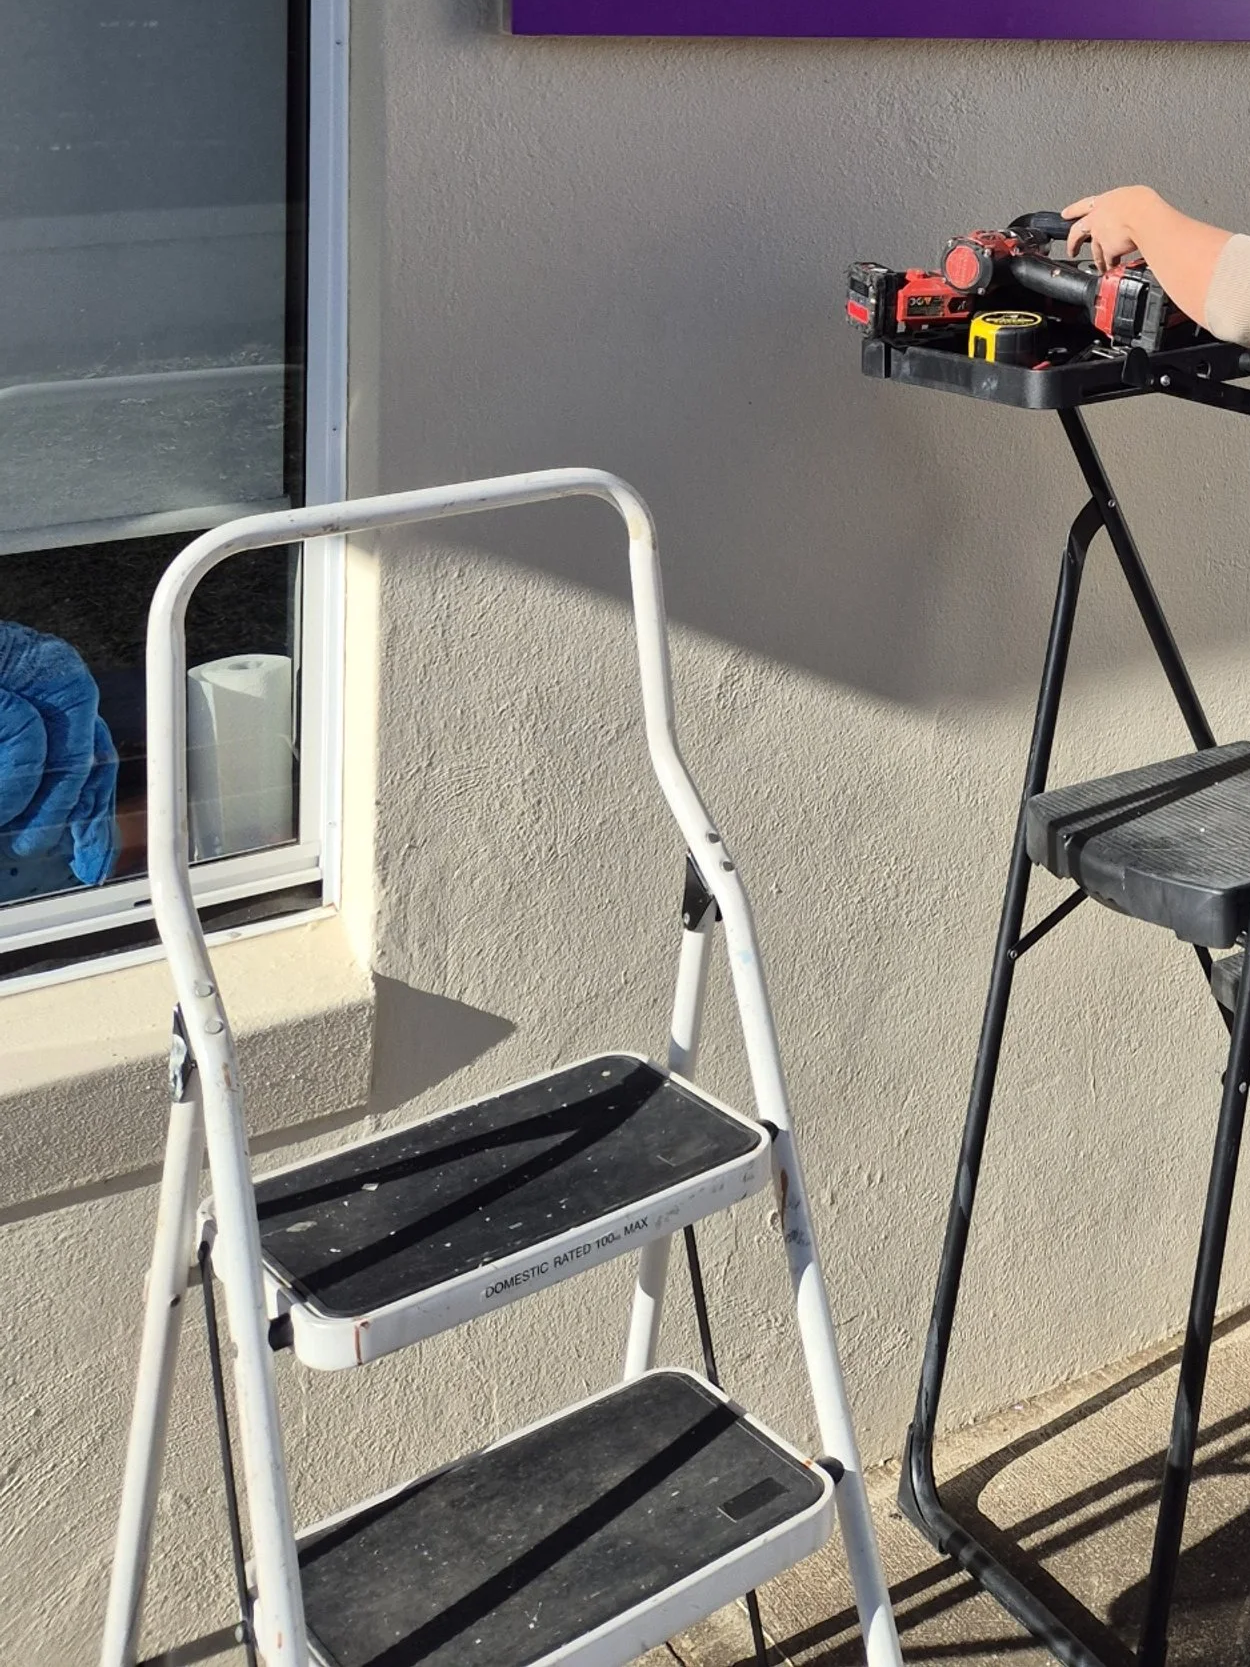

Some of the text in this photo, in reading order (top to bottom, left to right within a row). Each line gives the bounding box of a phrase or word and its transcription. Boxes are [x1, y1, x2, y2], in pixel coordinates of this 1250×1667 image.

[485, 1261, 549, 1299] DOMESTIC
[553, 1243, 592, 1269] RATED
[623, 1216, 649, 1236] MAX
